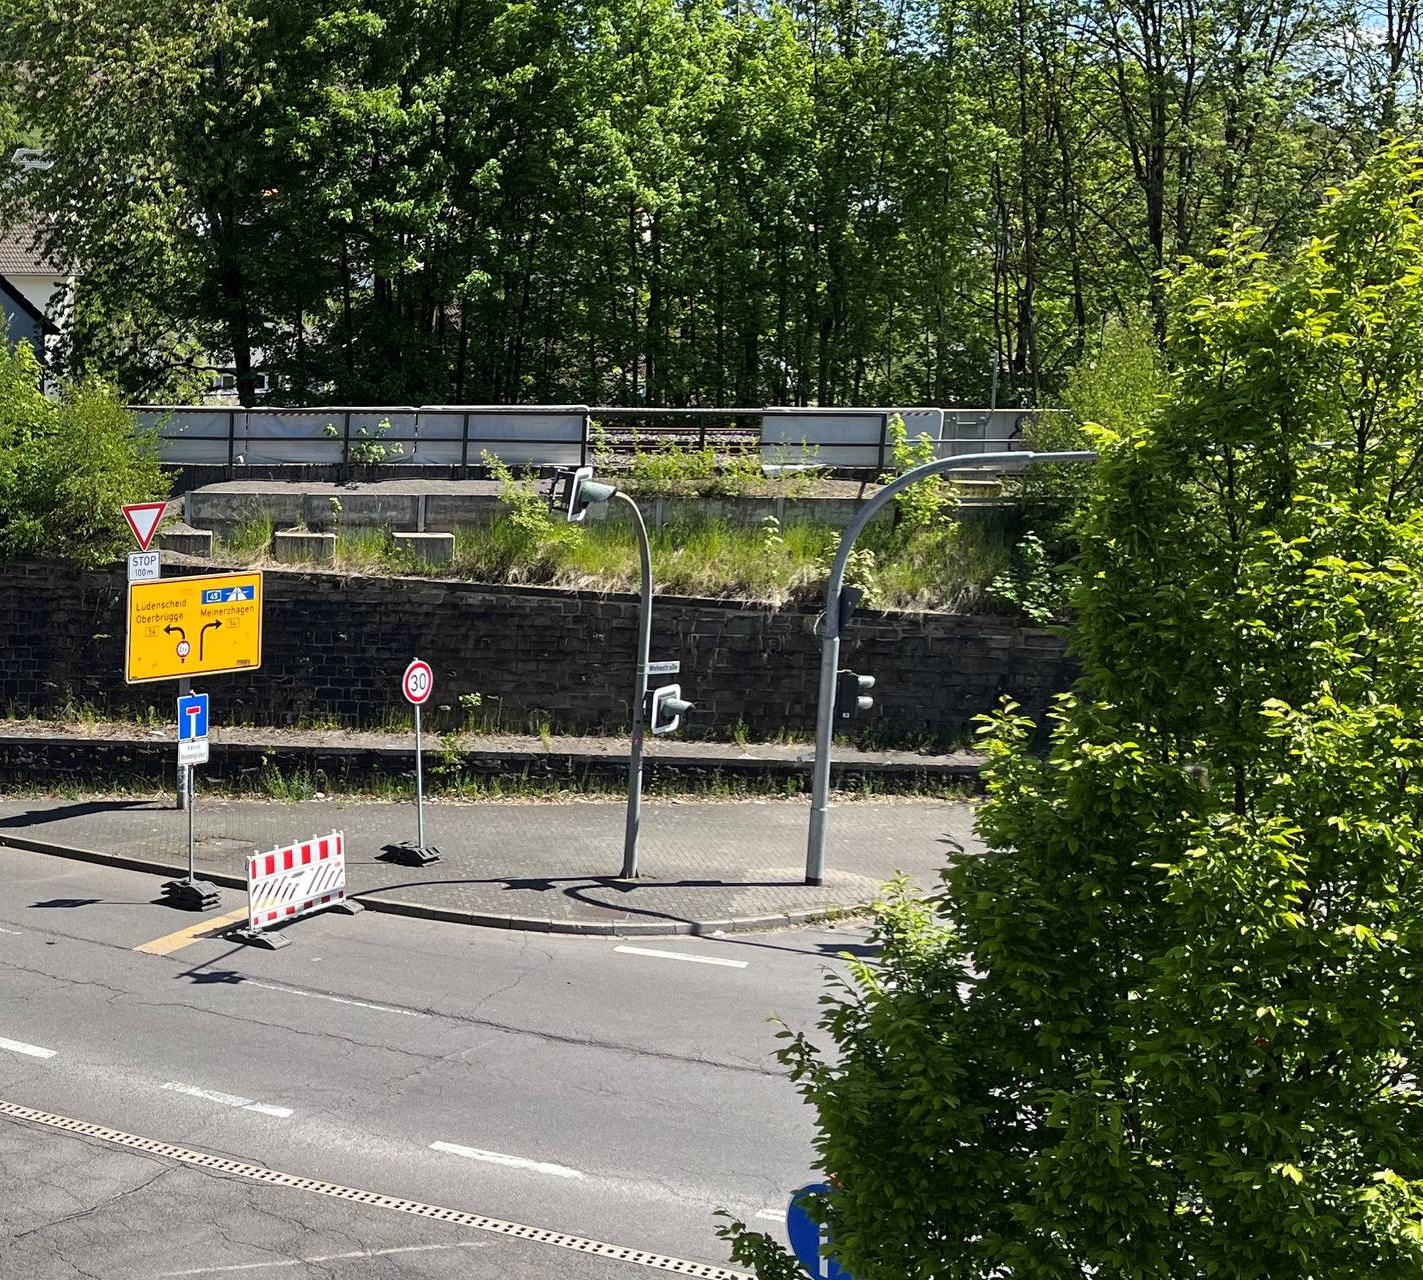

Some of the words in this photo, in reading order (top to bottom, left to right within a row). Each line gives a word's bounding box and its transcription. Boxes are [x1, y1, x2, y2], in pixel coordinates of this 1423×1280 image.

[132, 555, 157, 567] STOP
[201, 606, 254, 617] Meinerzhagen
[410, 672, 427, 692] 30
